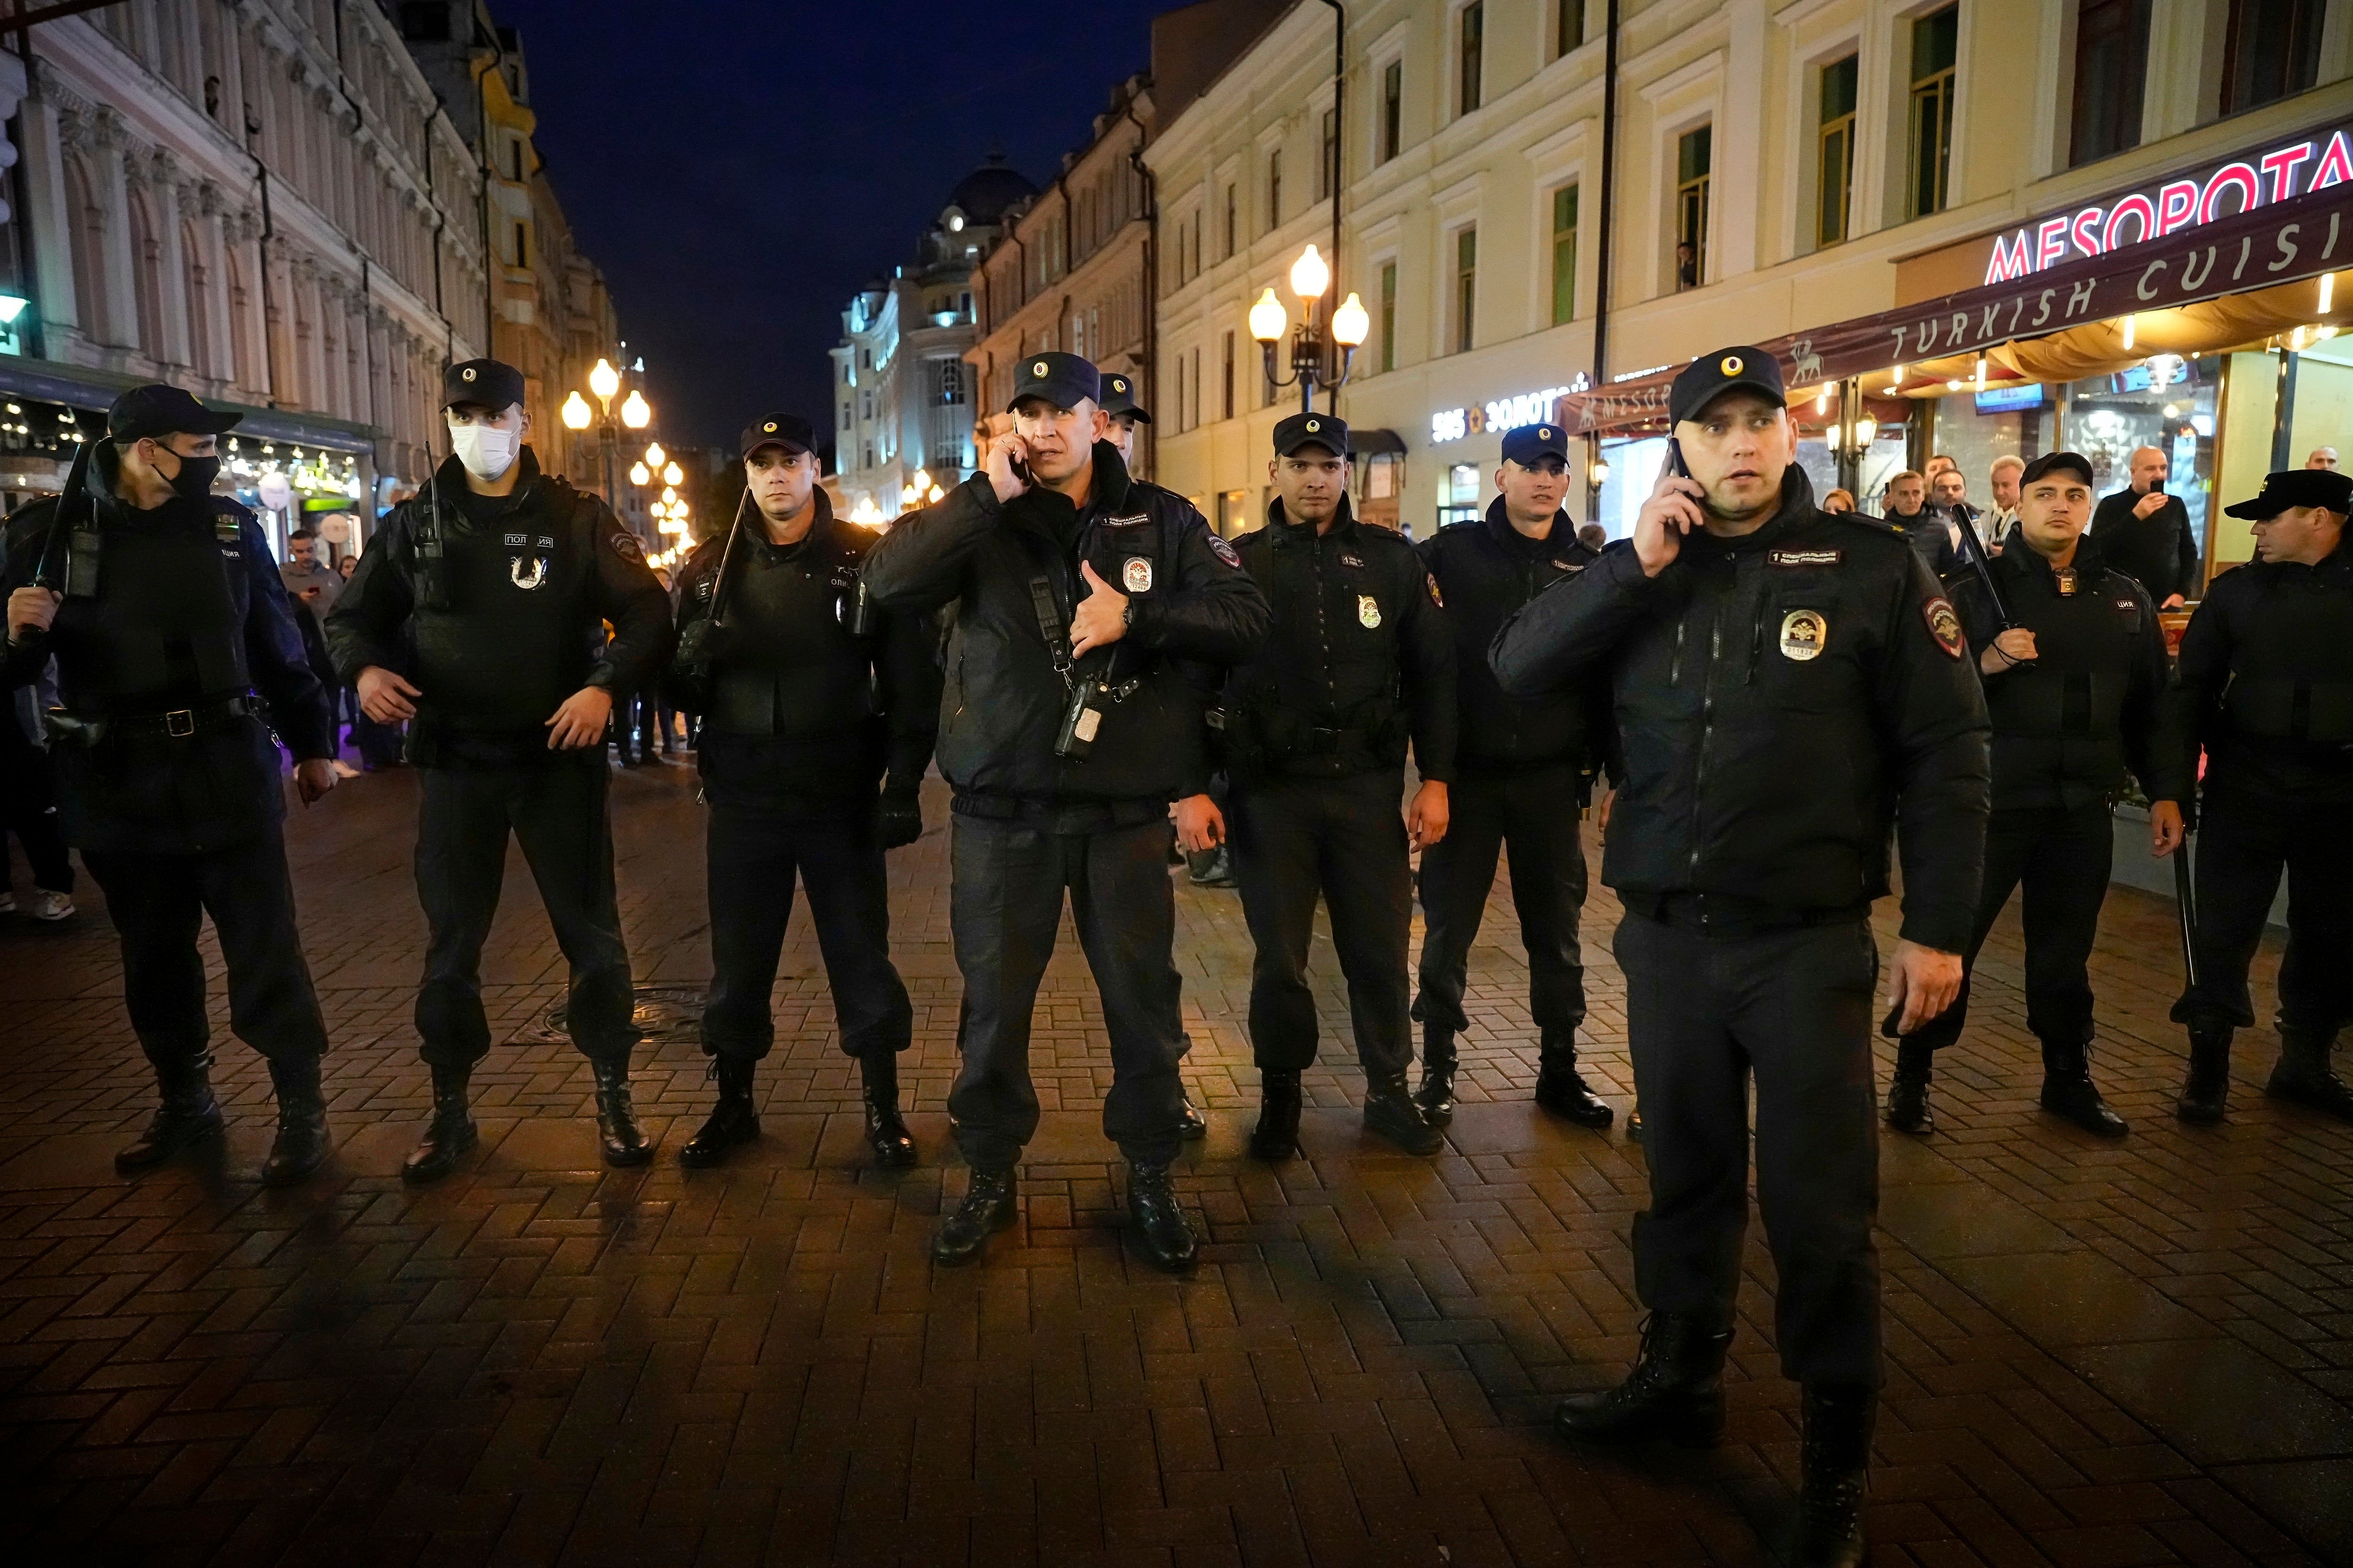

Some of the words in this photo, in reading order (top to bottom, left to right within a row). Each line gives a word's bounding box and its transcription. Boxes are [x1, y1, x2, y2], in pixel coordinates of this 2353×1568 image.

[1984, 130, 2353, 286] MESOPOTA
[1891, 278, 2096, 359] TURKISH
[2137, 212, 2340, 301] CUISI
[1486, 371, 1589, 432] ЗОЛОТ
[1109, 514, 1147, 522] СПЕЦИАЛЬНЫЙ
[507, 536, 551, 546] ПОЛИЯ
[1773, 553, 1778, 561] 1
